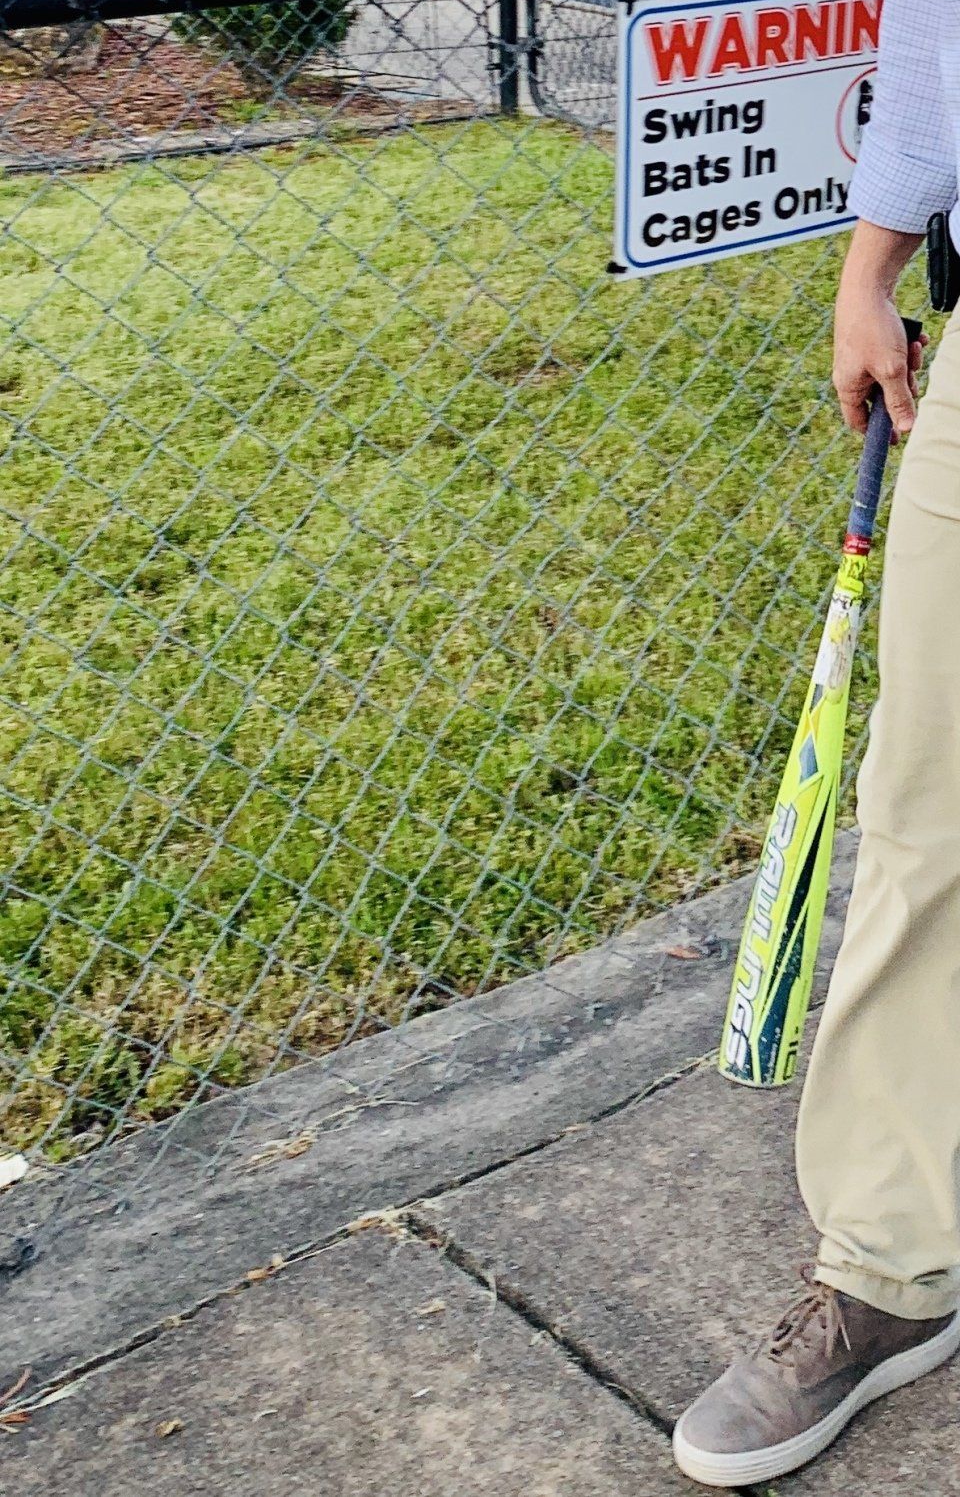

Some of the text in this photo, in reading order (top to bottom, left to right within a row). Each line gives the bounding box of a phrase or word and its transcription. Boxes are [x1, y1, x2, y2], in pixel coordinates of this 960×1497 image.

[642, 99, 764, 144] Swing
[643, 145, 776, 197] Bats In
[642, 177, 849, 247] Cages Only
[725, 801, 798, 1071] RAWLINGS
